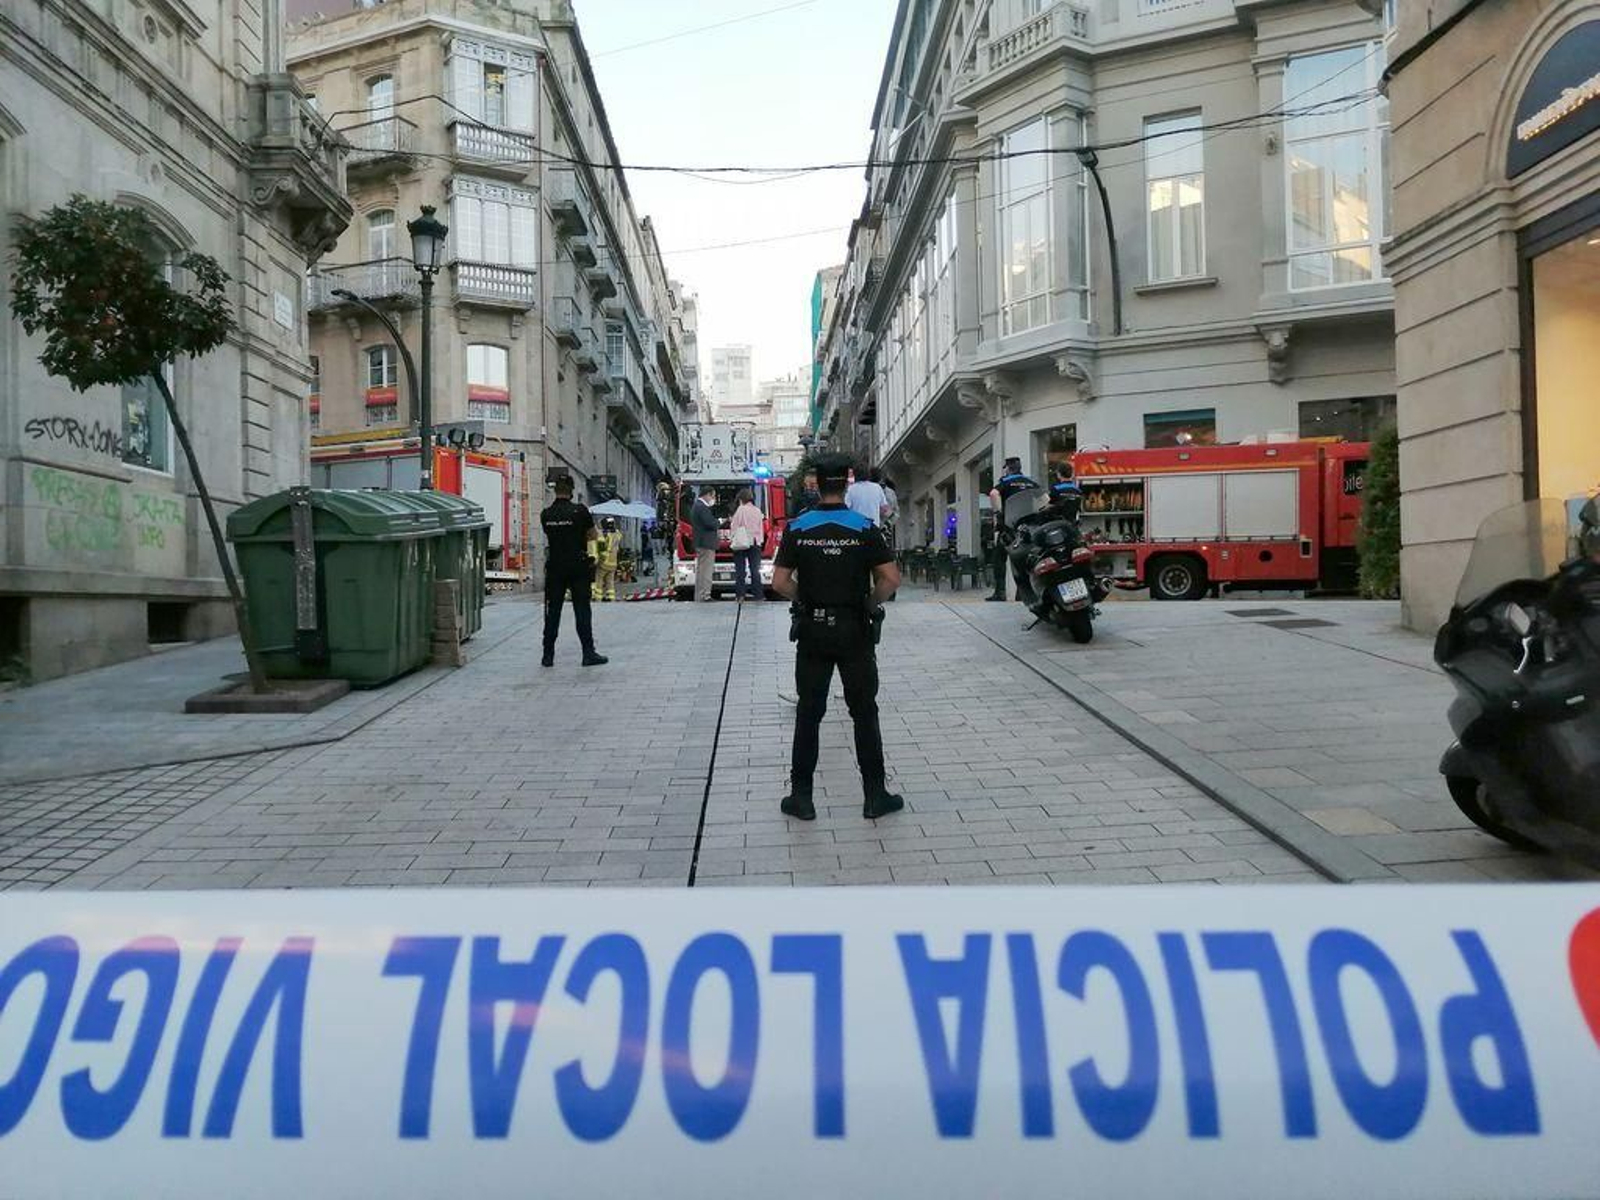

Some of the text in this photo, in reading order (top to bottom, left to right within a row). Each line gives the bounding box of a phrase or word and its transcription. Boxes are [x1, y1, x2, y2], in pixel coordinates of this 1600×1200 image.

[822, 547, 842, 556] VIGO
[0, 927, 1545, 1145] POLICIA LOCAL VIGO
